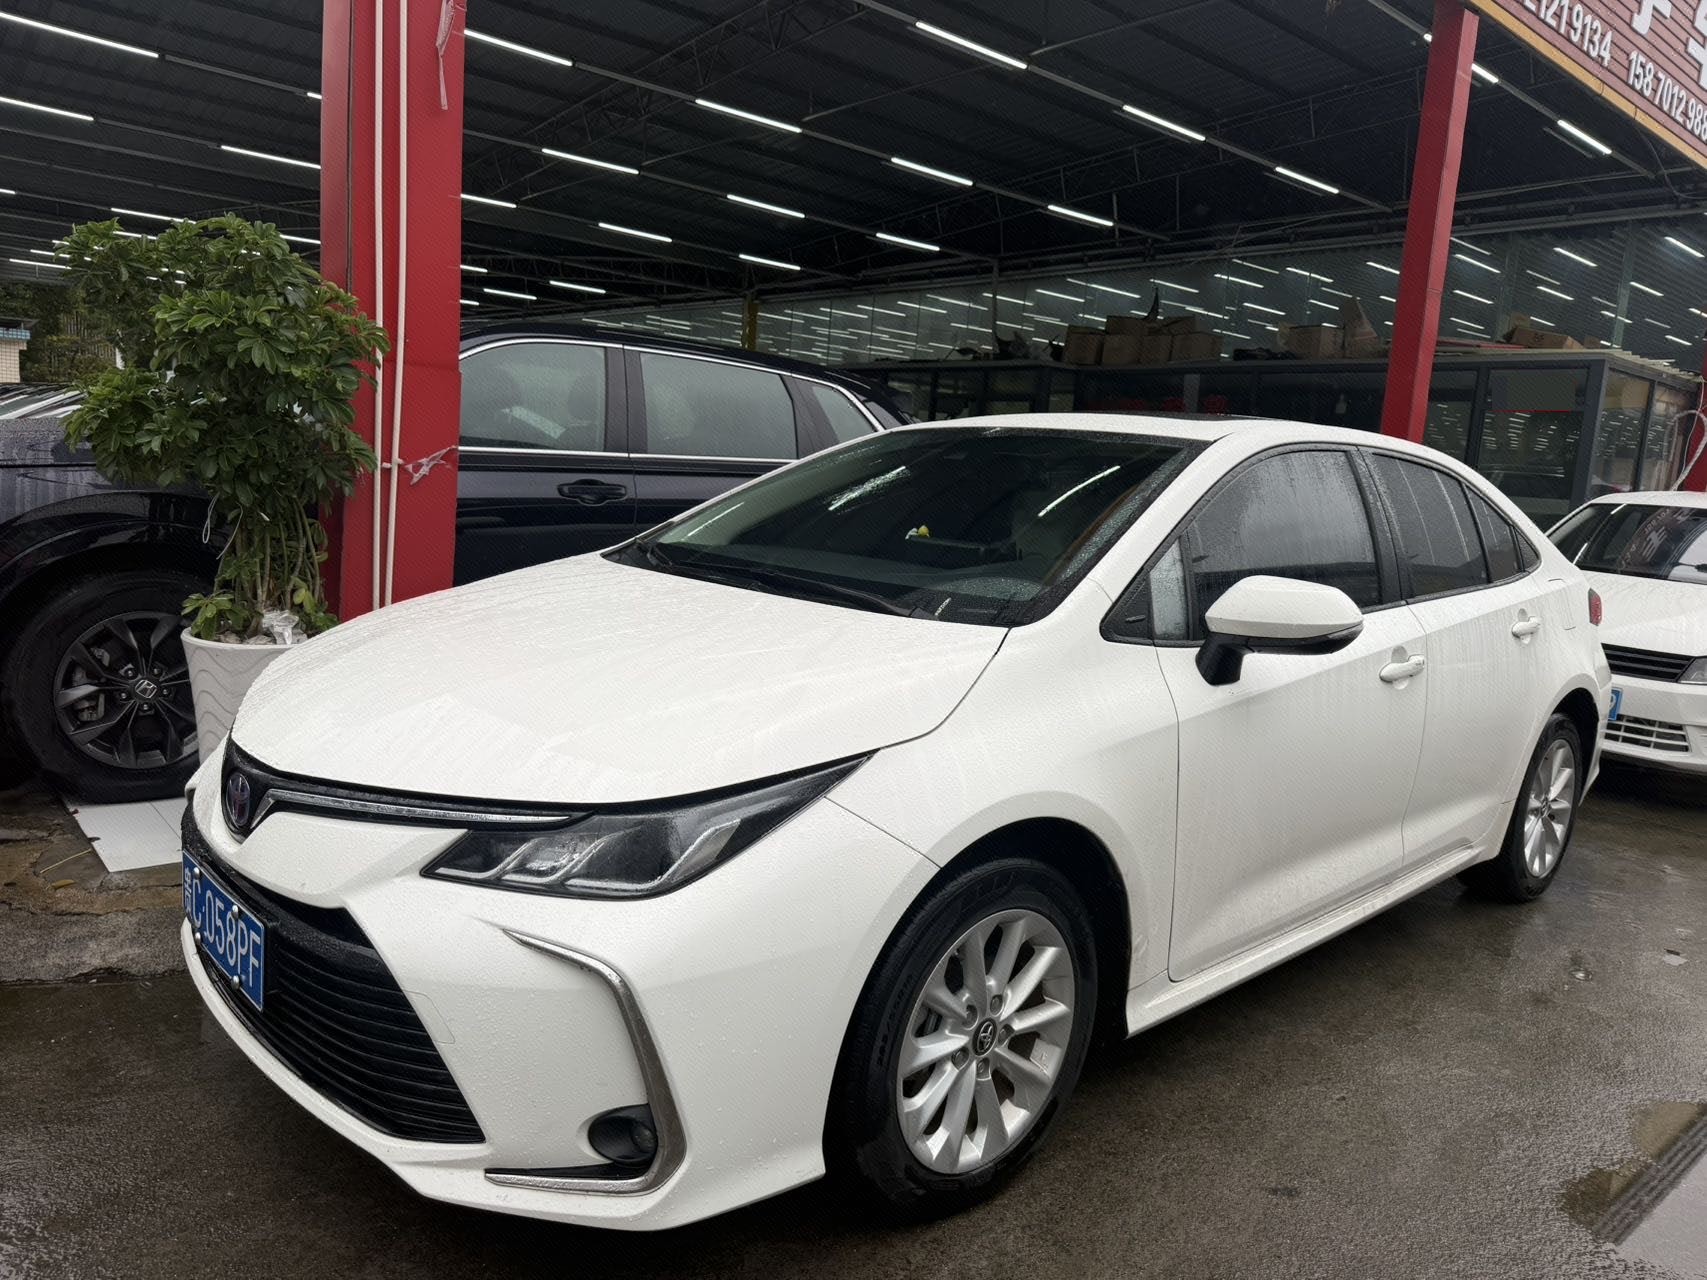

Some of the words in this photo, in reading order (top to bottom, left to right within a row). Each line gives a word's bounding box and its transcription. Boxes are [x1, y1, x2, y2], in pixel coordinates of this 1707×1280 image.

[1570, 3, 1613, 67] 9134
[1628, 50, 1655, 97] 158
[1654, 70, 1687, 123] 7012
